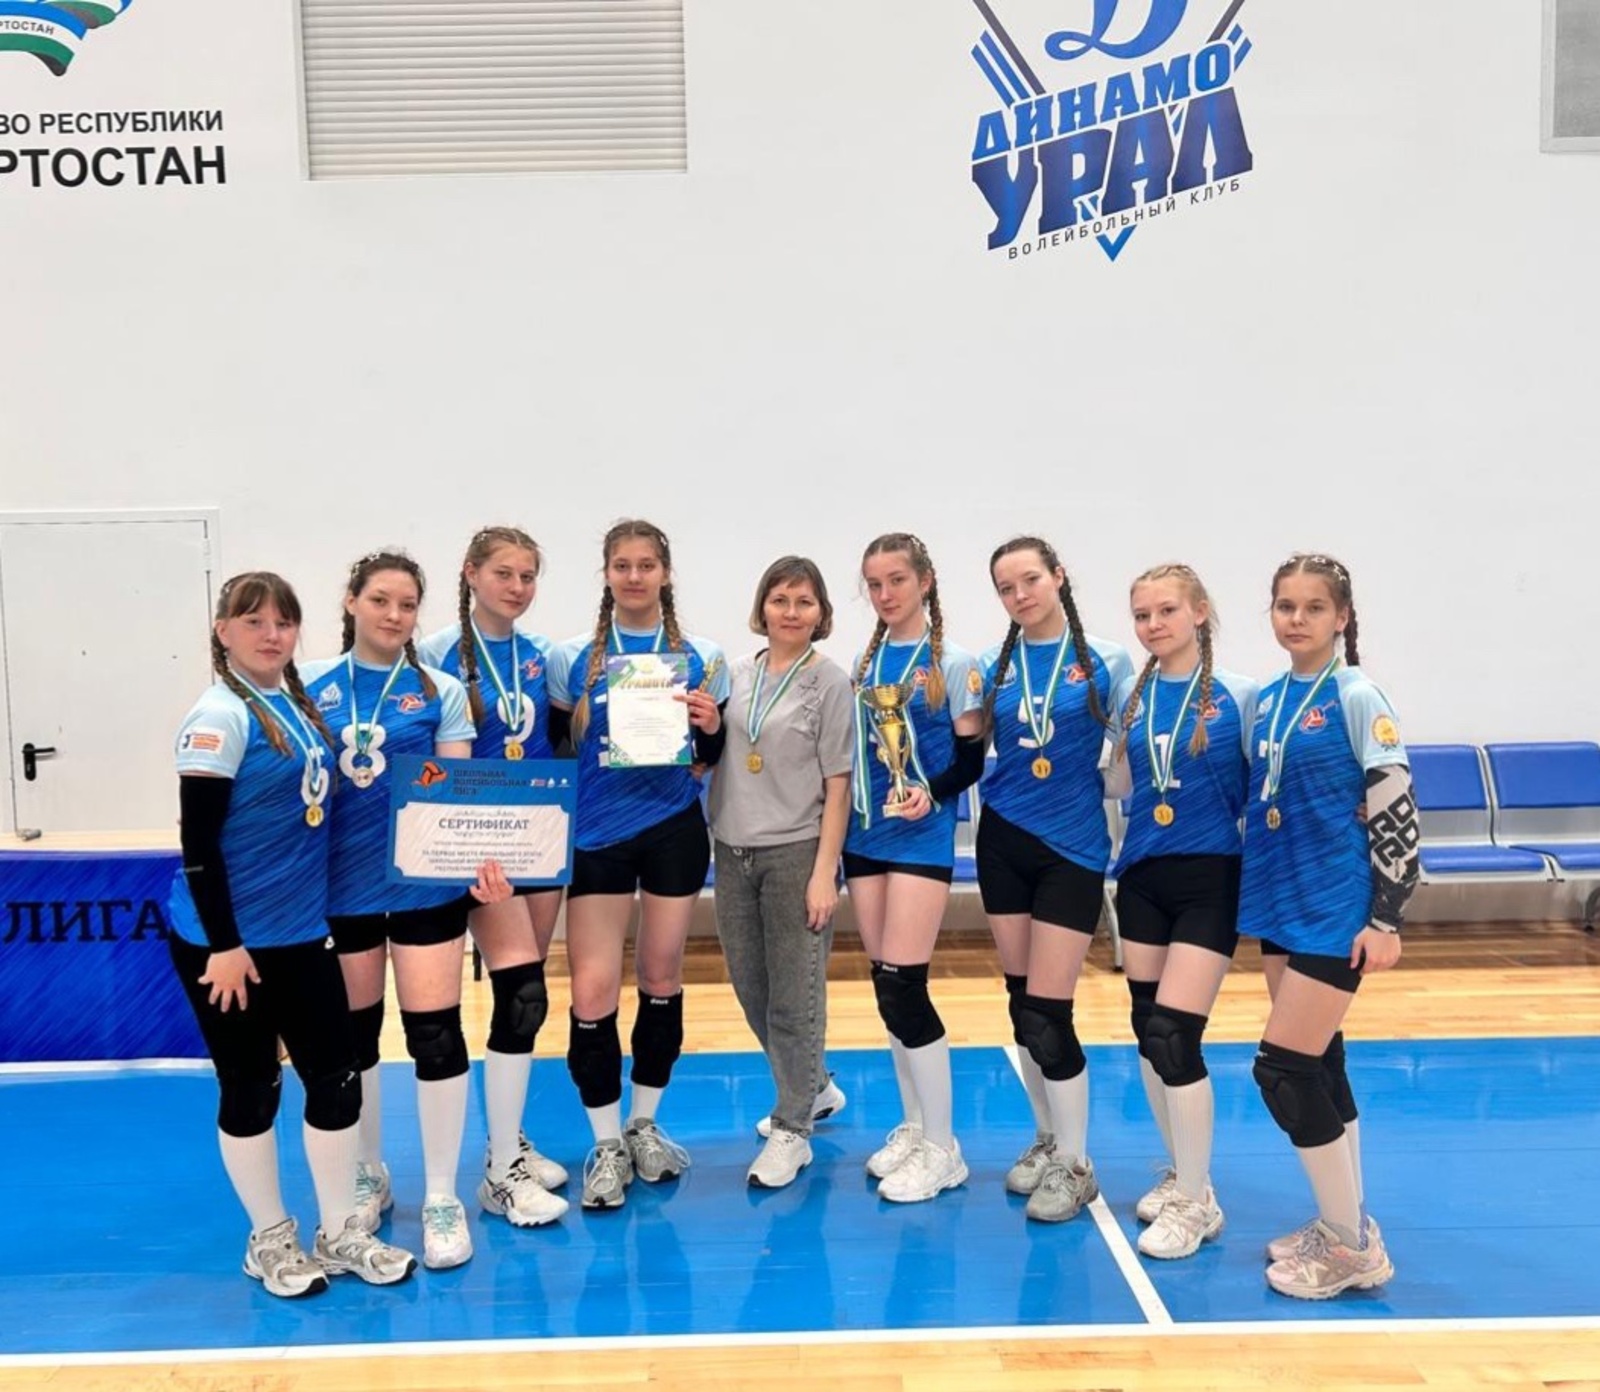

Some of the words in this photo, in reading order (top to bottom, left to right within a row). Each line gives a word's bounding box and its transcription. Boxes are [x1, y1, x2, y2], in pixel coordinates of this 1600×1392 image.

[39, 110, 223, 134] РЕСПУБЛИКИ
[972, 43, 1231, 161] ДИНАМО
[972, 87, 1253, 250] УРАЛ
[1008, 196, 1176, 259] ВОЛЕЙБОЛЬНЫЙ
[1190, 179, 1241, 205] КЛУБ
[497, 692, 535, 745] 9
[339, 722, 387, 780] 8
[438, 817, 530, 830] СЕРТИФИКАТ
[2, 900, 169, 943] ЛИГА
